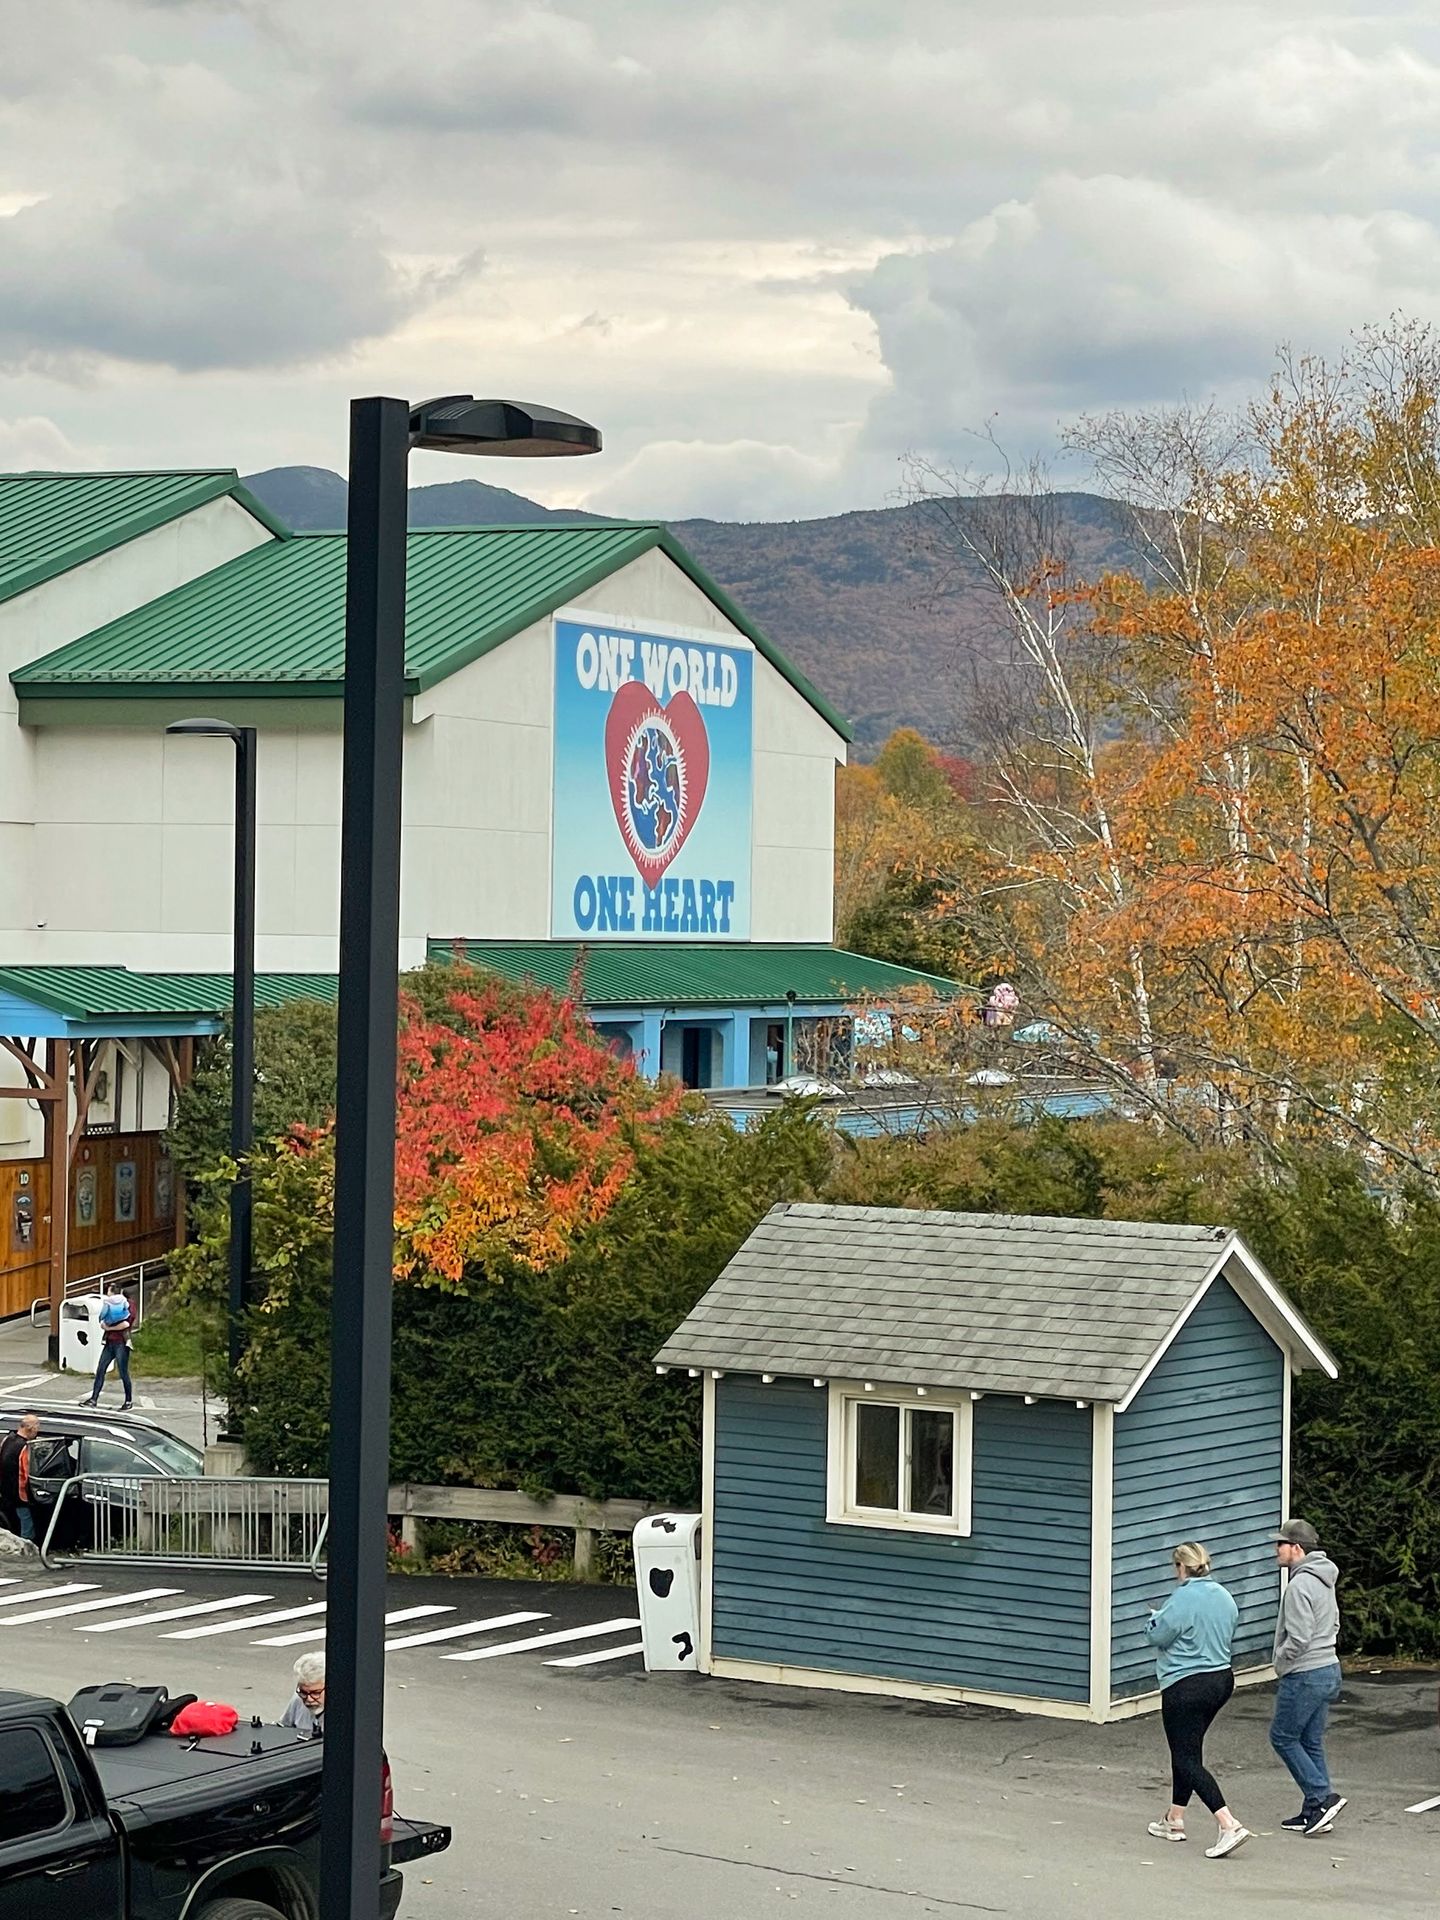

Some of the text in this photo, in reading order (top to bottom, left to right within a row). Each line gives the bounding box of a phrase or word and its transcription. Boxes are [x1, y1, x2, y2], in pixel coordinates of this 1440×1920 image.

[576, 632, 738, 708] ONE WORLD
[574, 875, 735, 933] ONE HEART
